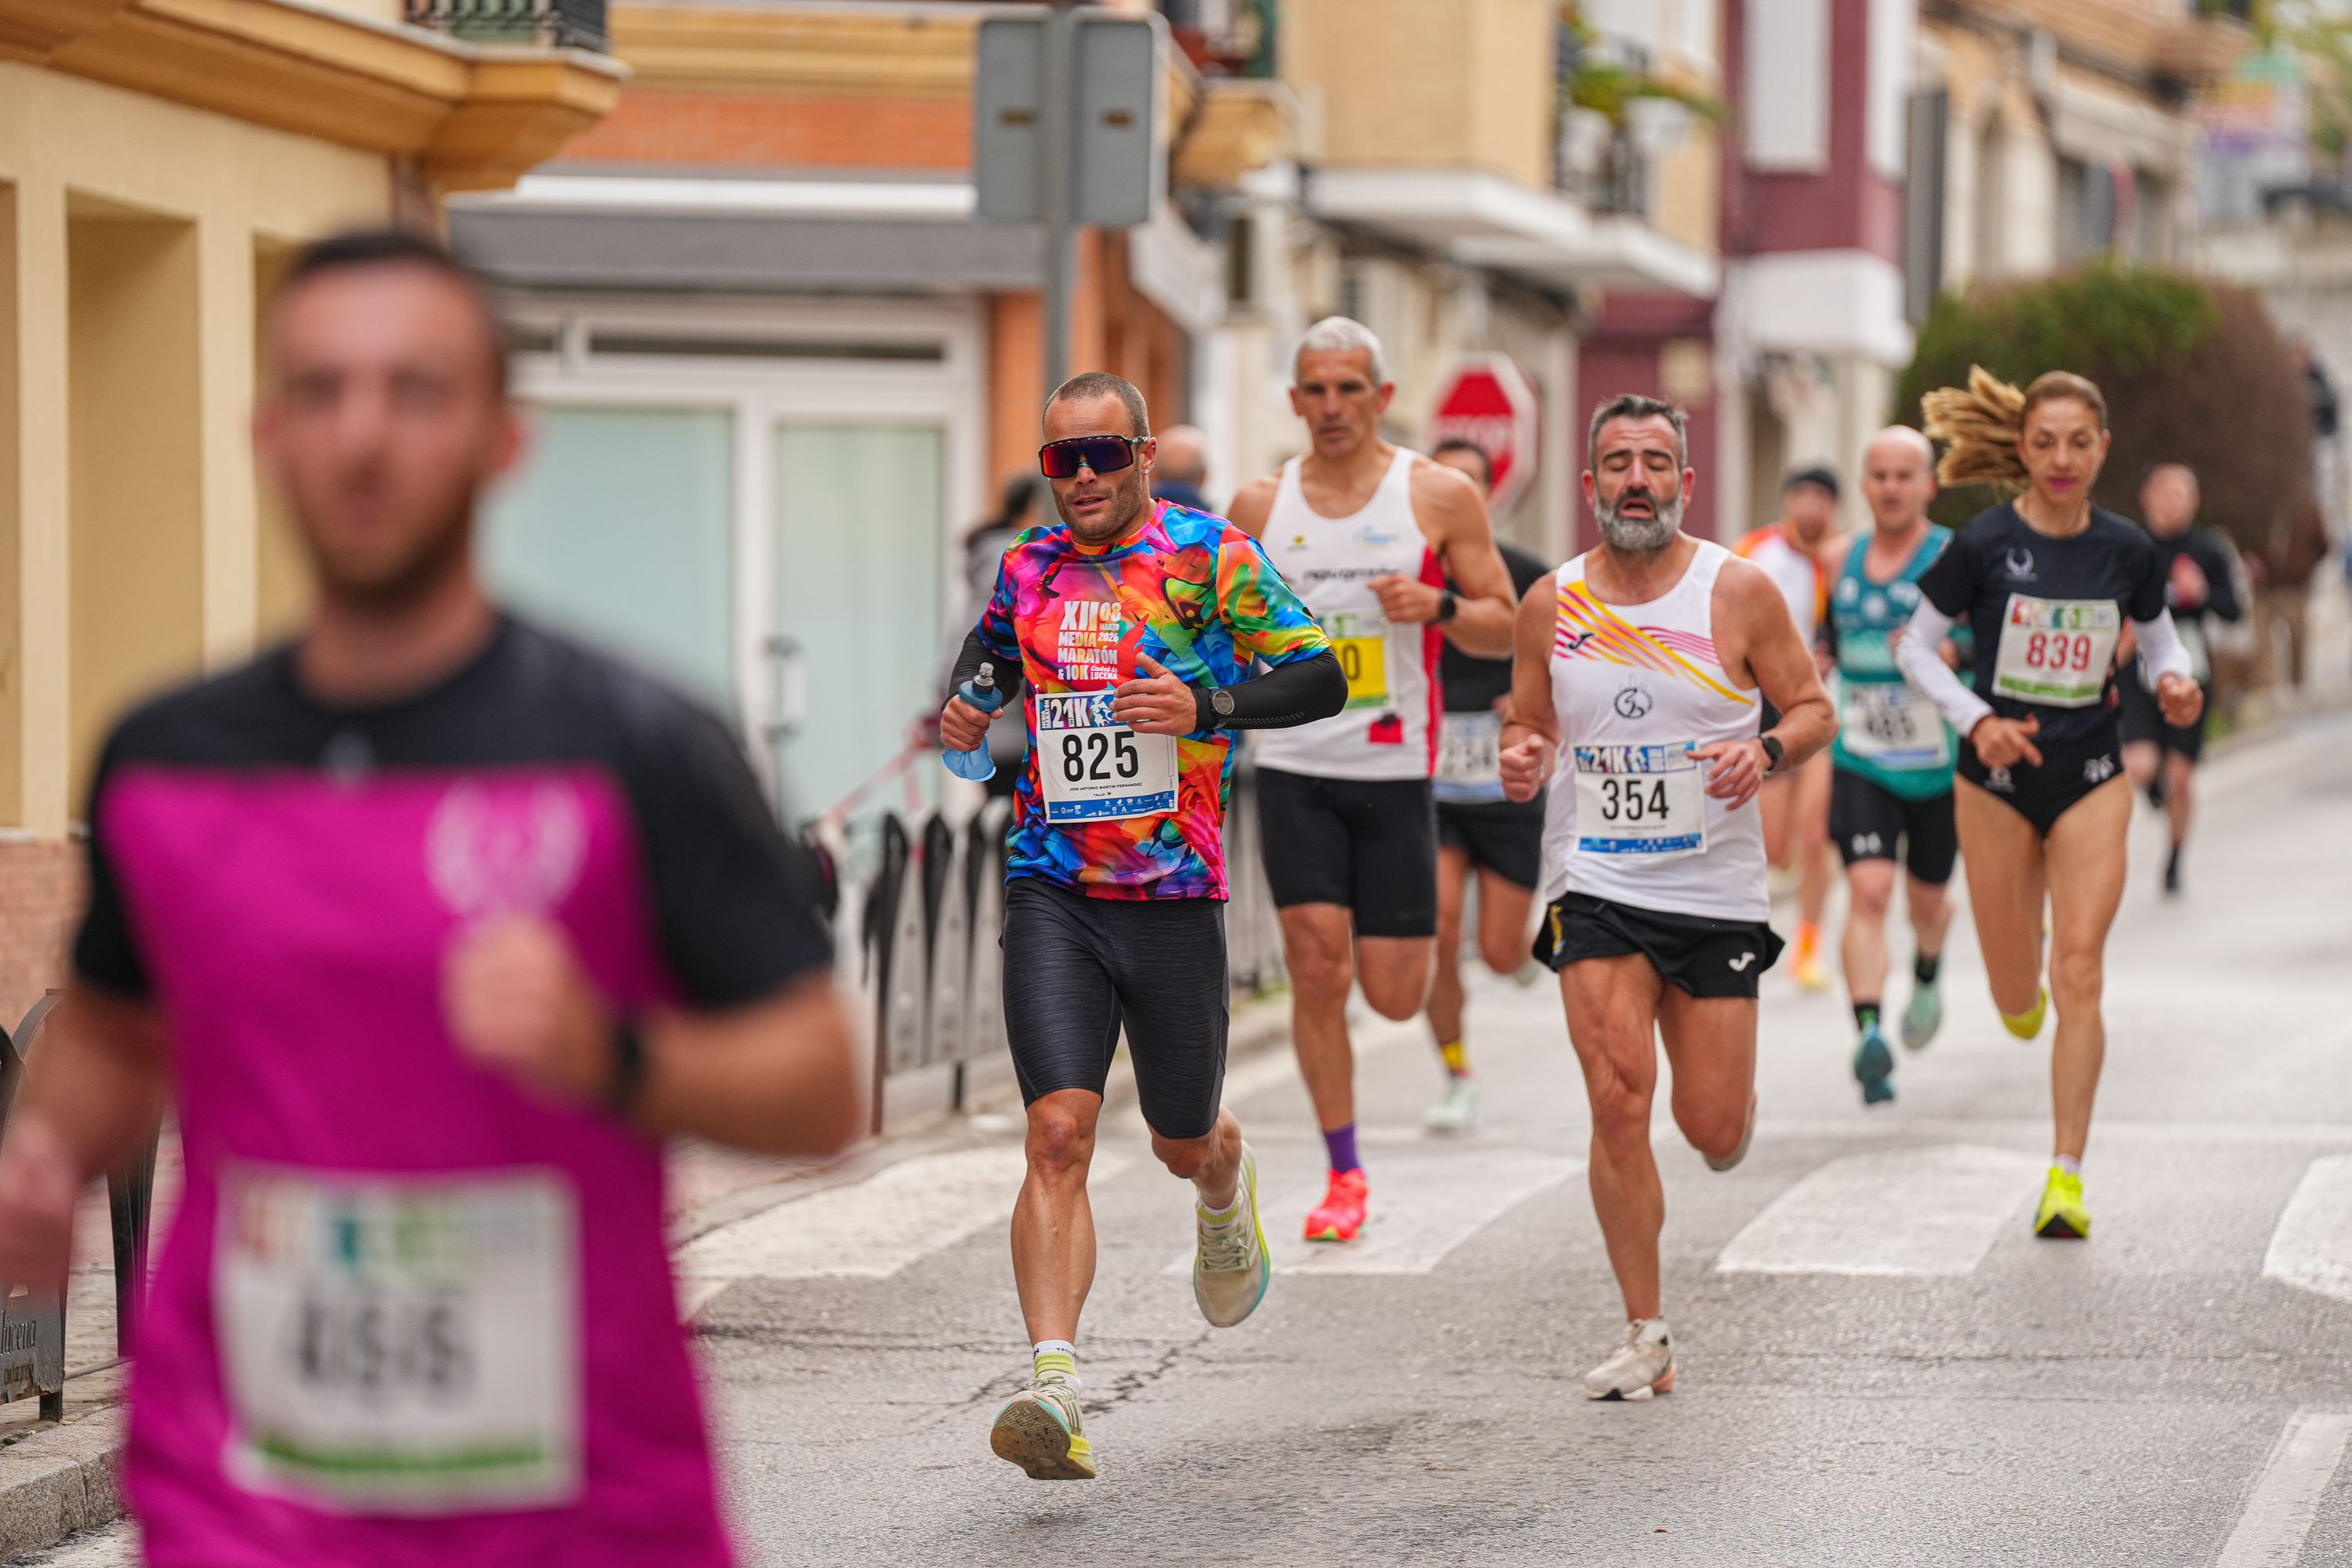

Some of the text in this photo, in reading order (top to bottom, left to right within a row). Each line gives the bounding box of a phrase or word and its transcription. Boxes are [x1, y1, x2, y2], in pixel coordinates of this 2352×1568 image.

[1059, 601, 1099, 631] XII
[1099, 602, 1121, 622] 08
[1058, 632, 1098, 647] MEDIA
[1098, 632, 1120, 642] 2026
[1058, 645, 1117, 665] MARATÓN
[2026, 632, 2091, 672] 839
[1065, 665, 1089, 680] 10K
[1051, 698, 1091, 728] 21K
[1062, 731, 1139, 782] 825
[1591, 746, 1628, 773] 21K
[1602, 779, 1670, 821] 354
